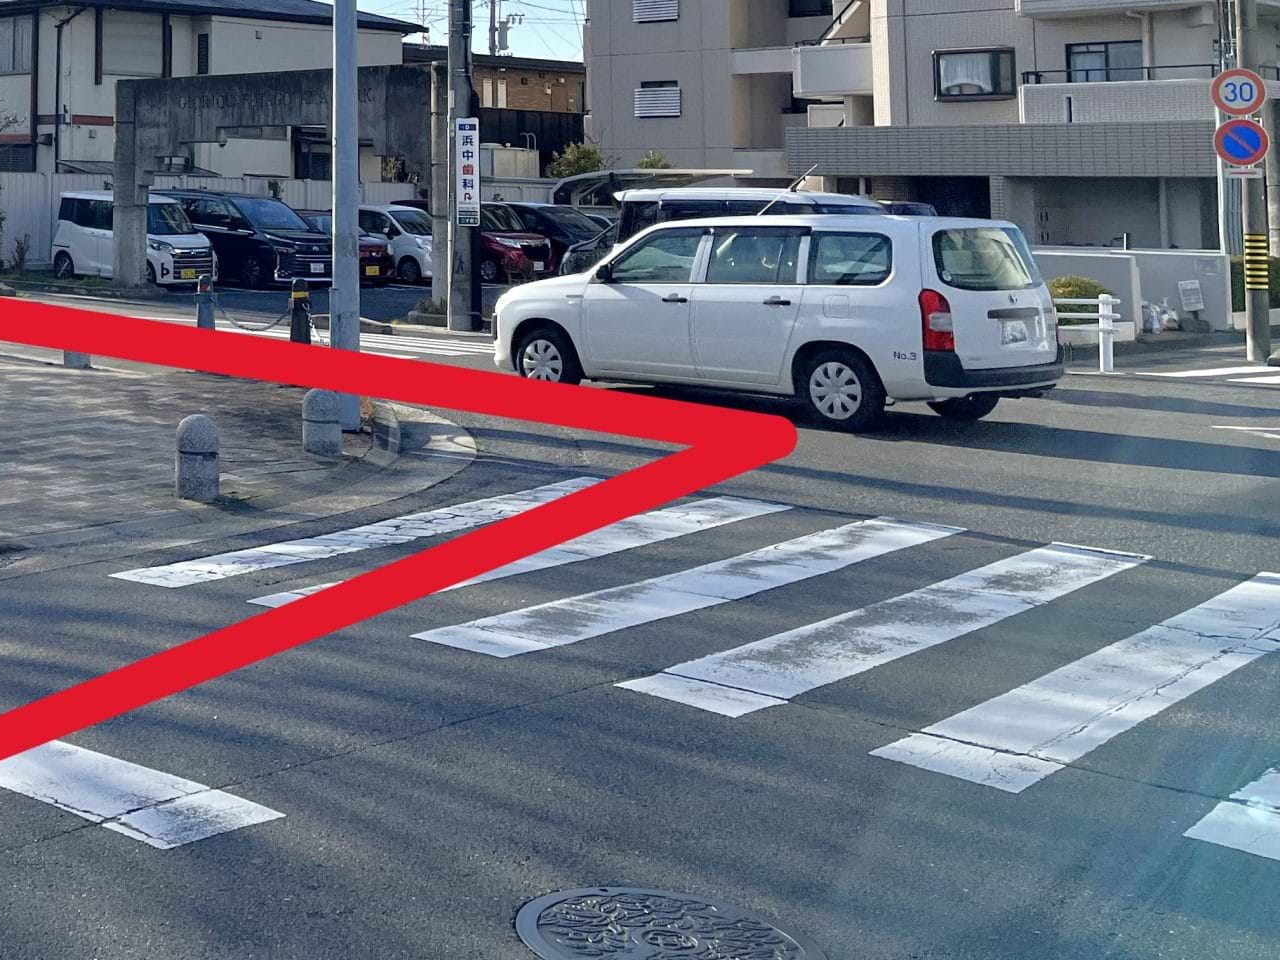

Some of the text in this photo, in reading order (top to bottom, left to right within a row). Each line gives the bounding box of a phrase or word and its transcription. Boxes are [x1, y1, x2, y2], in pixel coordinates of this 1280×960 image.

[1223, 82, 1254, 103] 30
[462, 134, 474, 190] 浜中歯科
[893, 351, 917, 361] No.3
